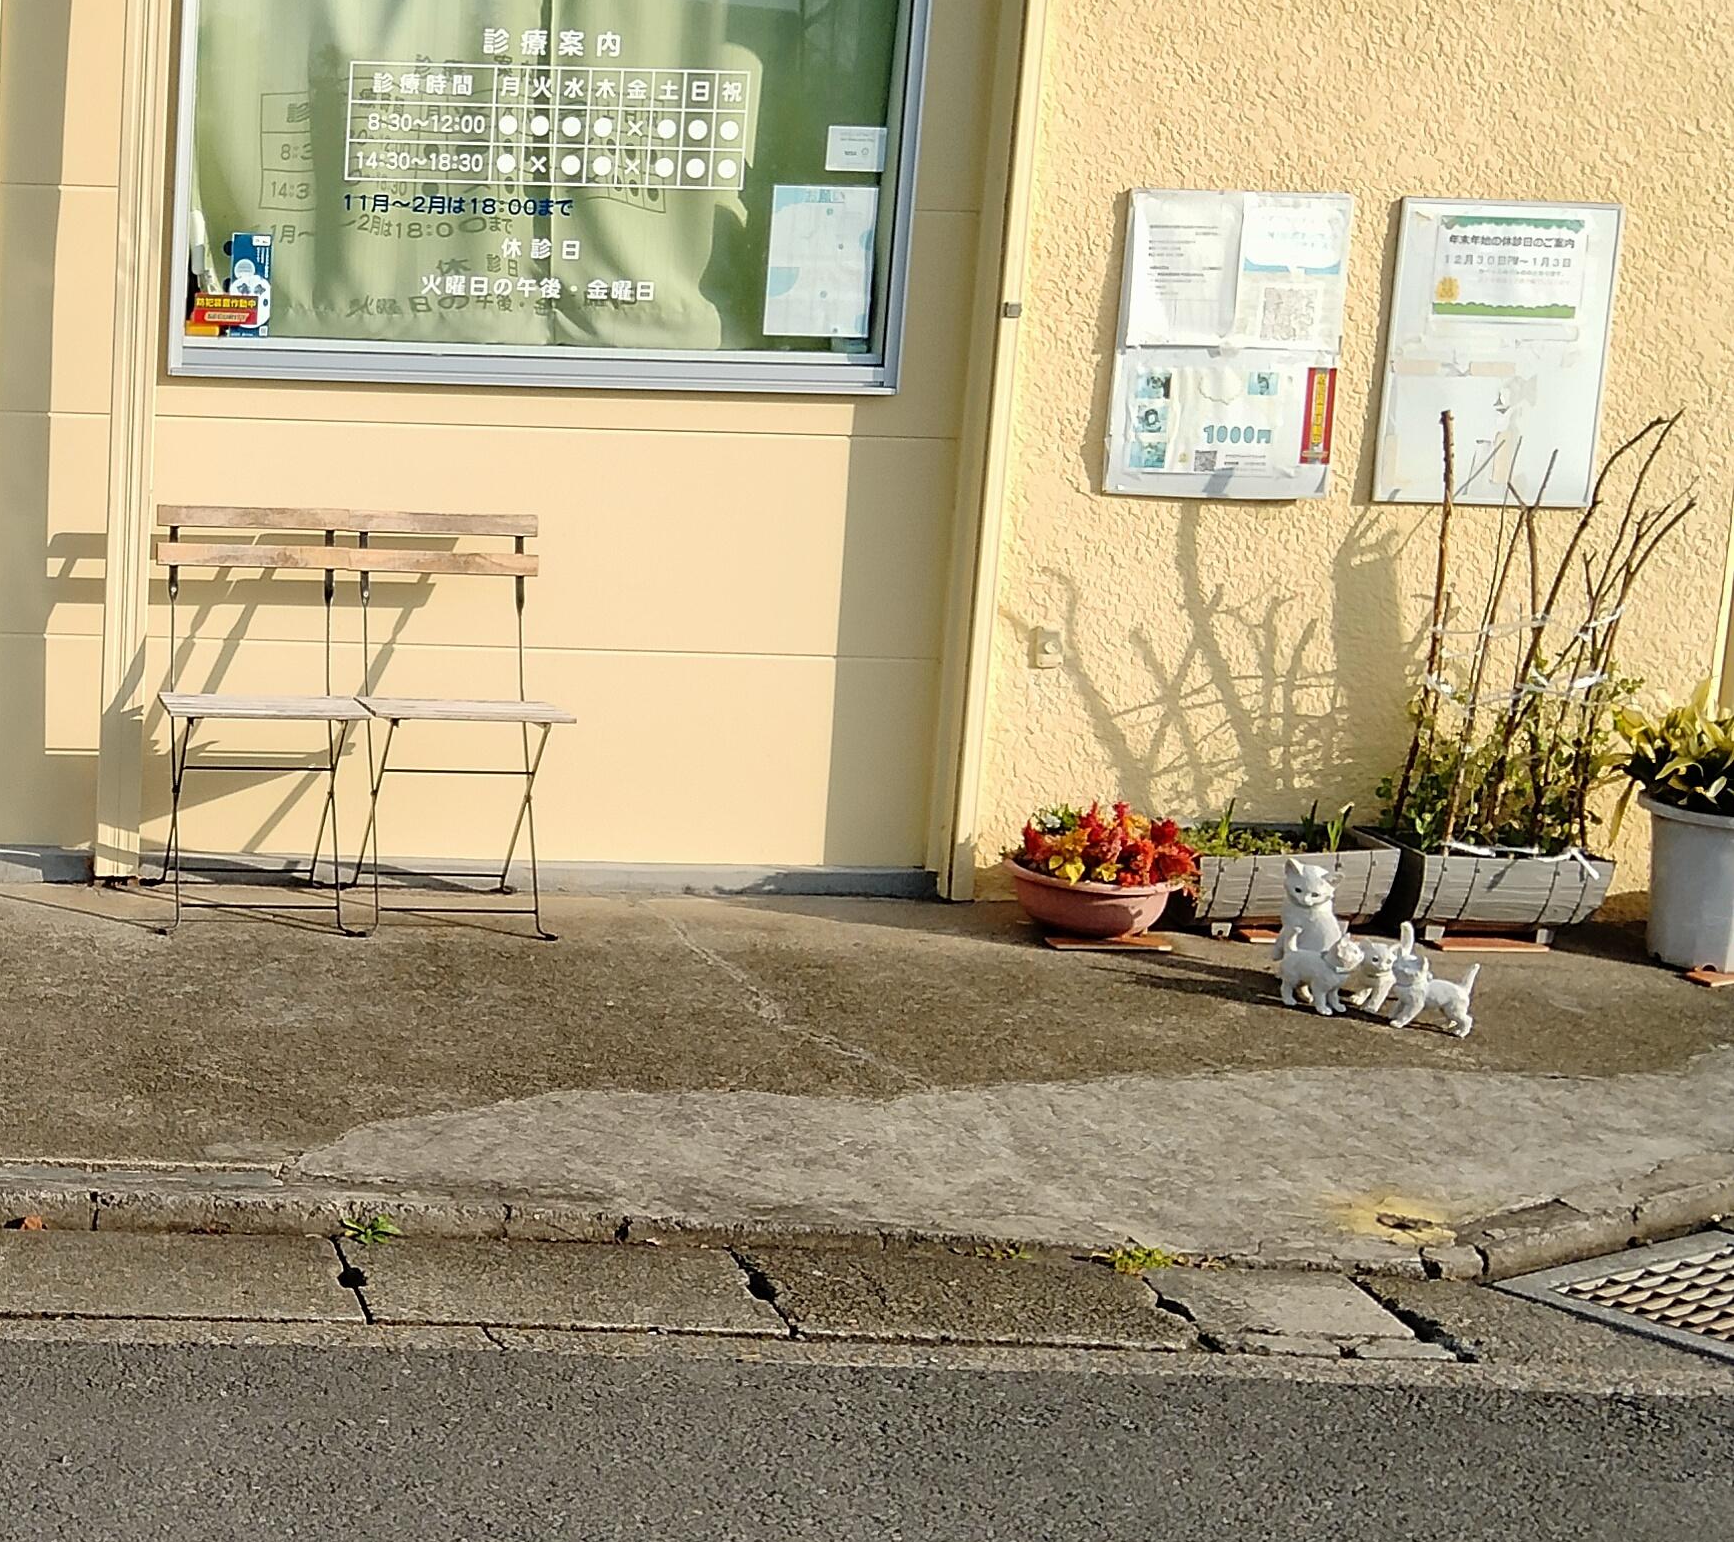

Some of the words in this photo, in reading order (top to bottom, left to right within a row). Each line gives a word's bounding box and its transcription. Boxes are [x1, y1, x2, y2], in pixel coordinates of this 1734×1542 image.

[482, 27, 621, 58] 診療案内
[372, 72, 474, 96] 診療時間
[500, 75, 520, 97] 月
[532, 76, 553, 99] 火
[564, 77, 585, 99] 水
[595, 78, 616, 100] 木
[626, 79, 647, 100] 金
[658, 80, 679, 100] 土
[691, 80, 710, 101] 日
[721, 81, 742, 102] 祝
[501, 238, 581, 260] 休診日
[1203, 425, 1272, 445] 1000円
